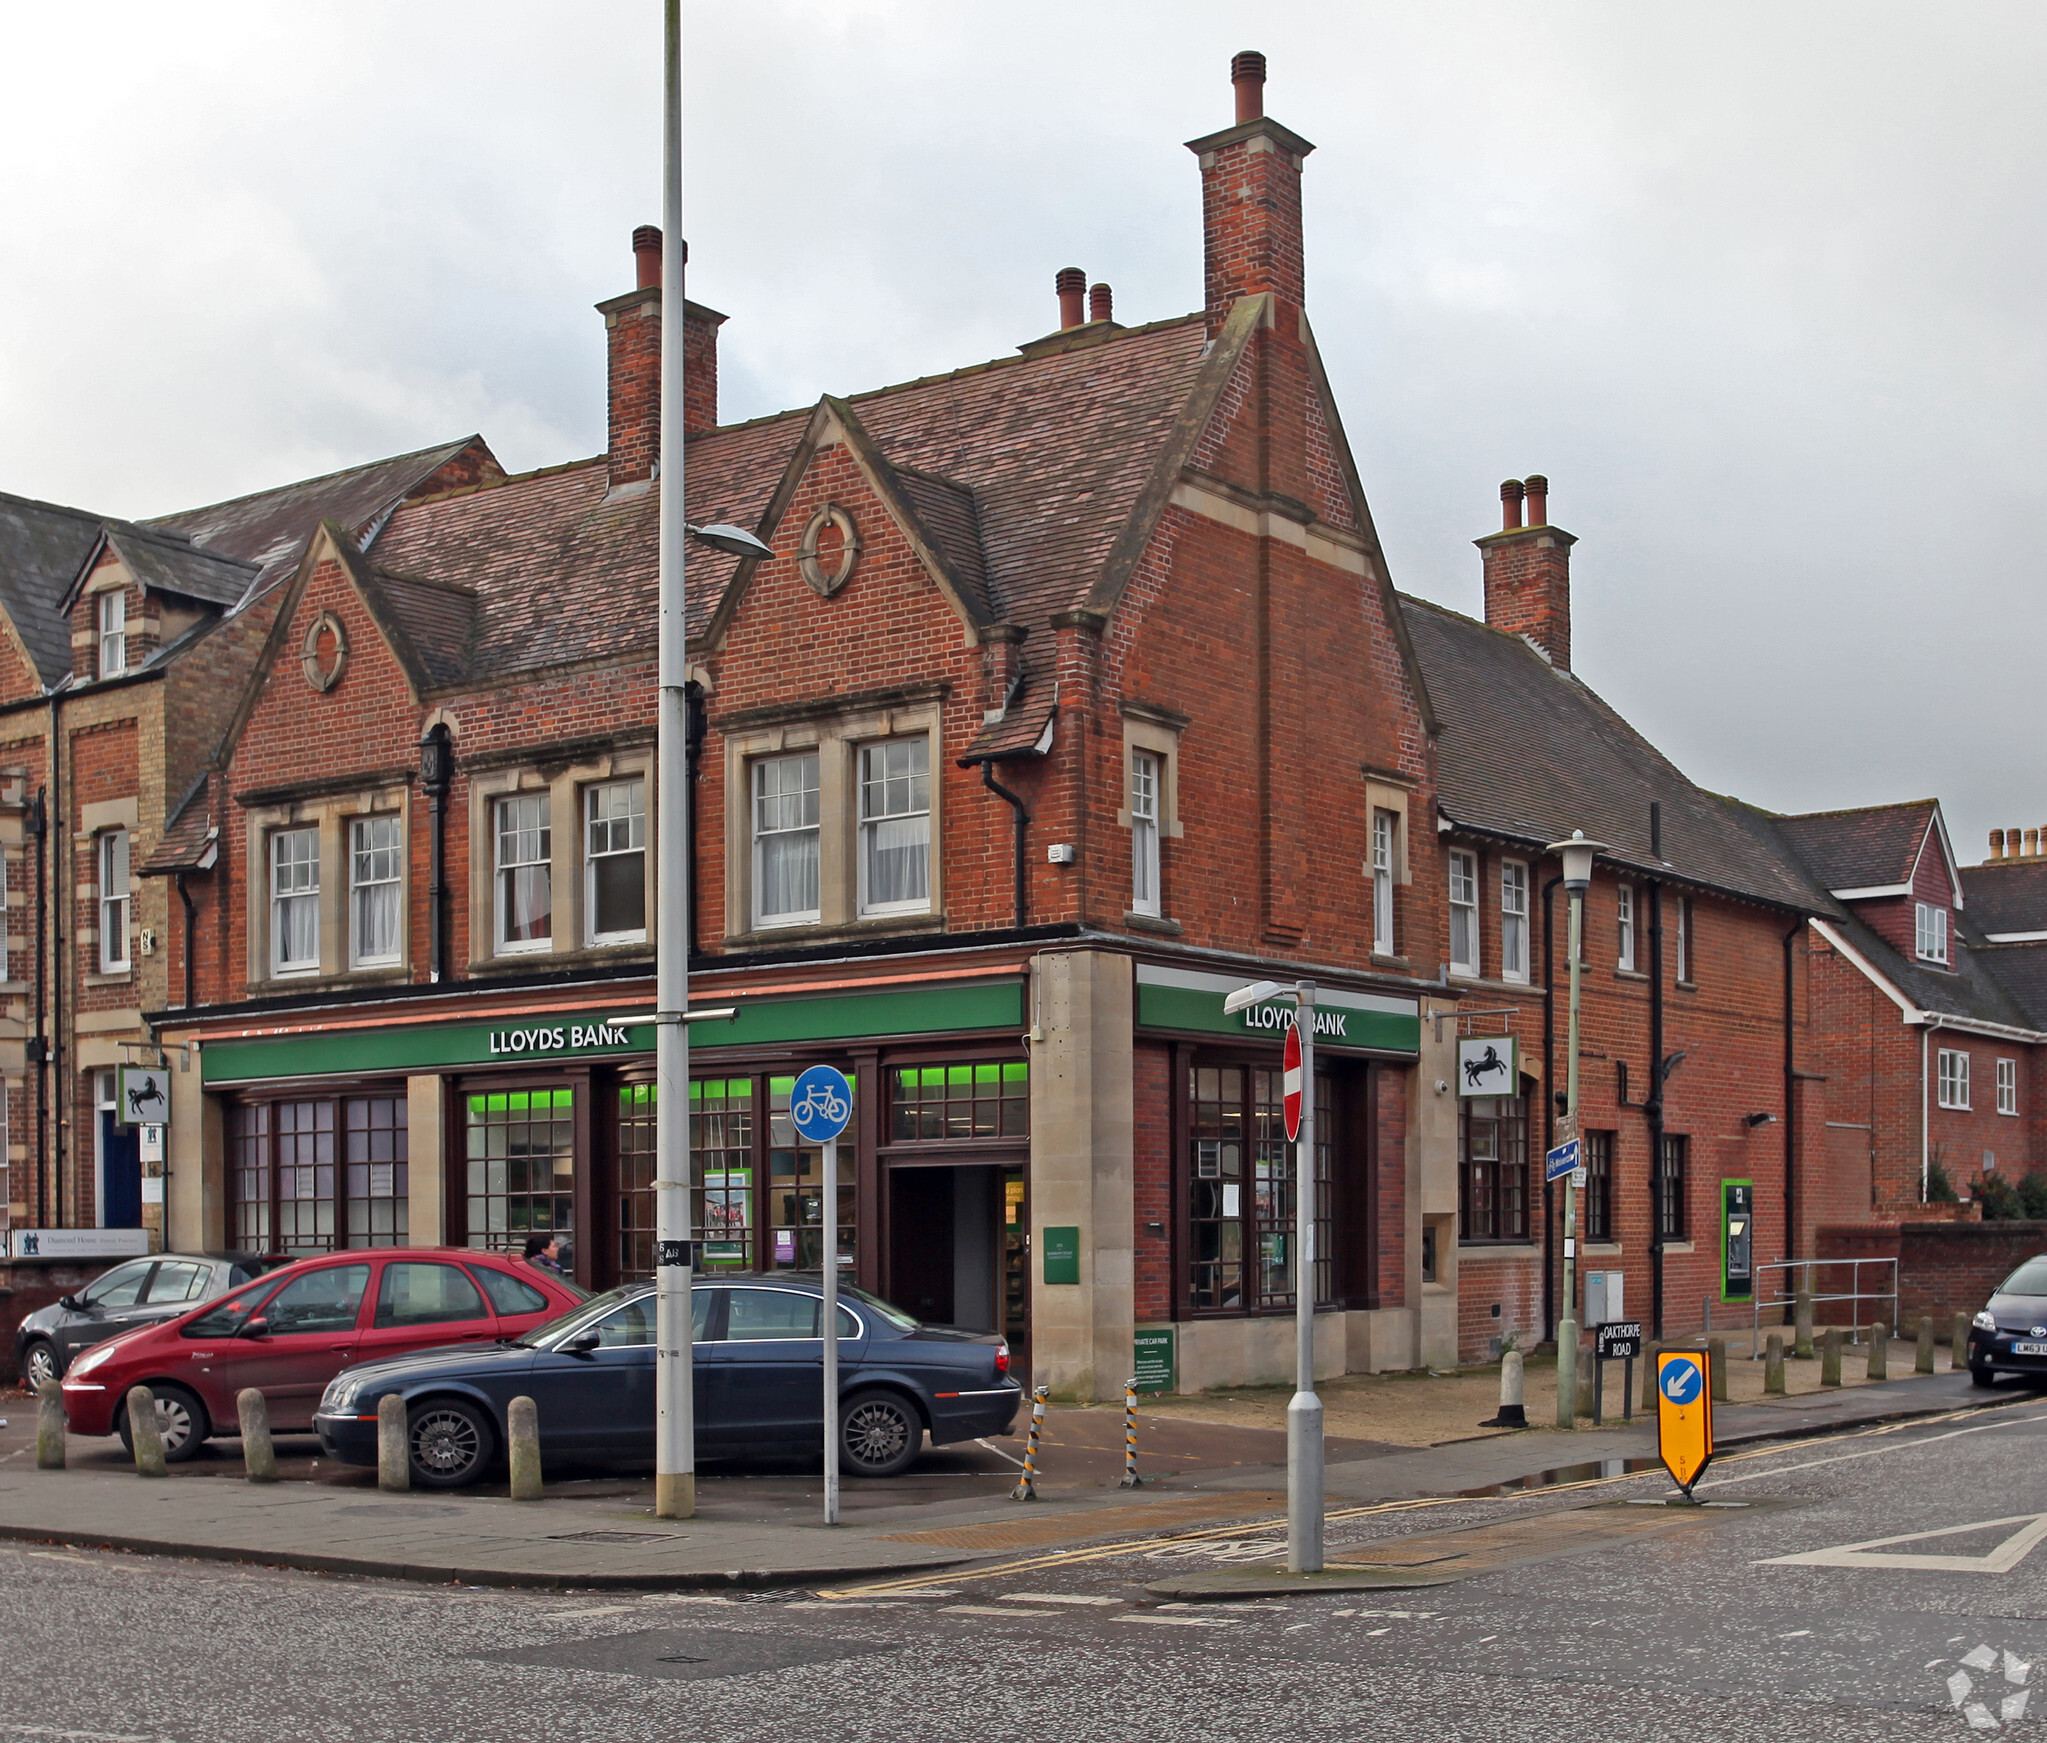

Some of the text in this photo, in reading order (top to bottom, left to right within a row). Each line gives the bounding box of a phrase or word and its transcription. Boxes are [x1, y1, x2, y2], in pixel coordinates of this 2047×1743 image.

[490, 1024, 629, 1053] LLOYDS BANK
[1604, 1324, 1641, 1339] OAKTHORPE
[1612, 1342, 1632, 1356] ROAD
